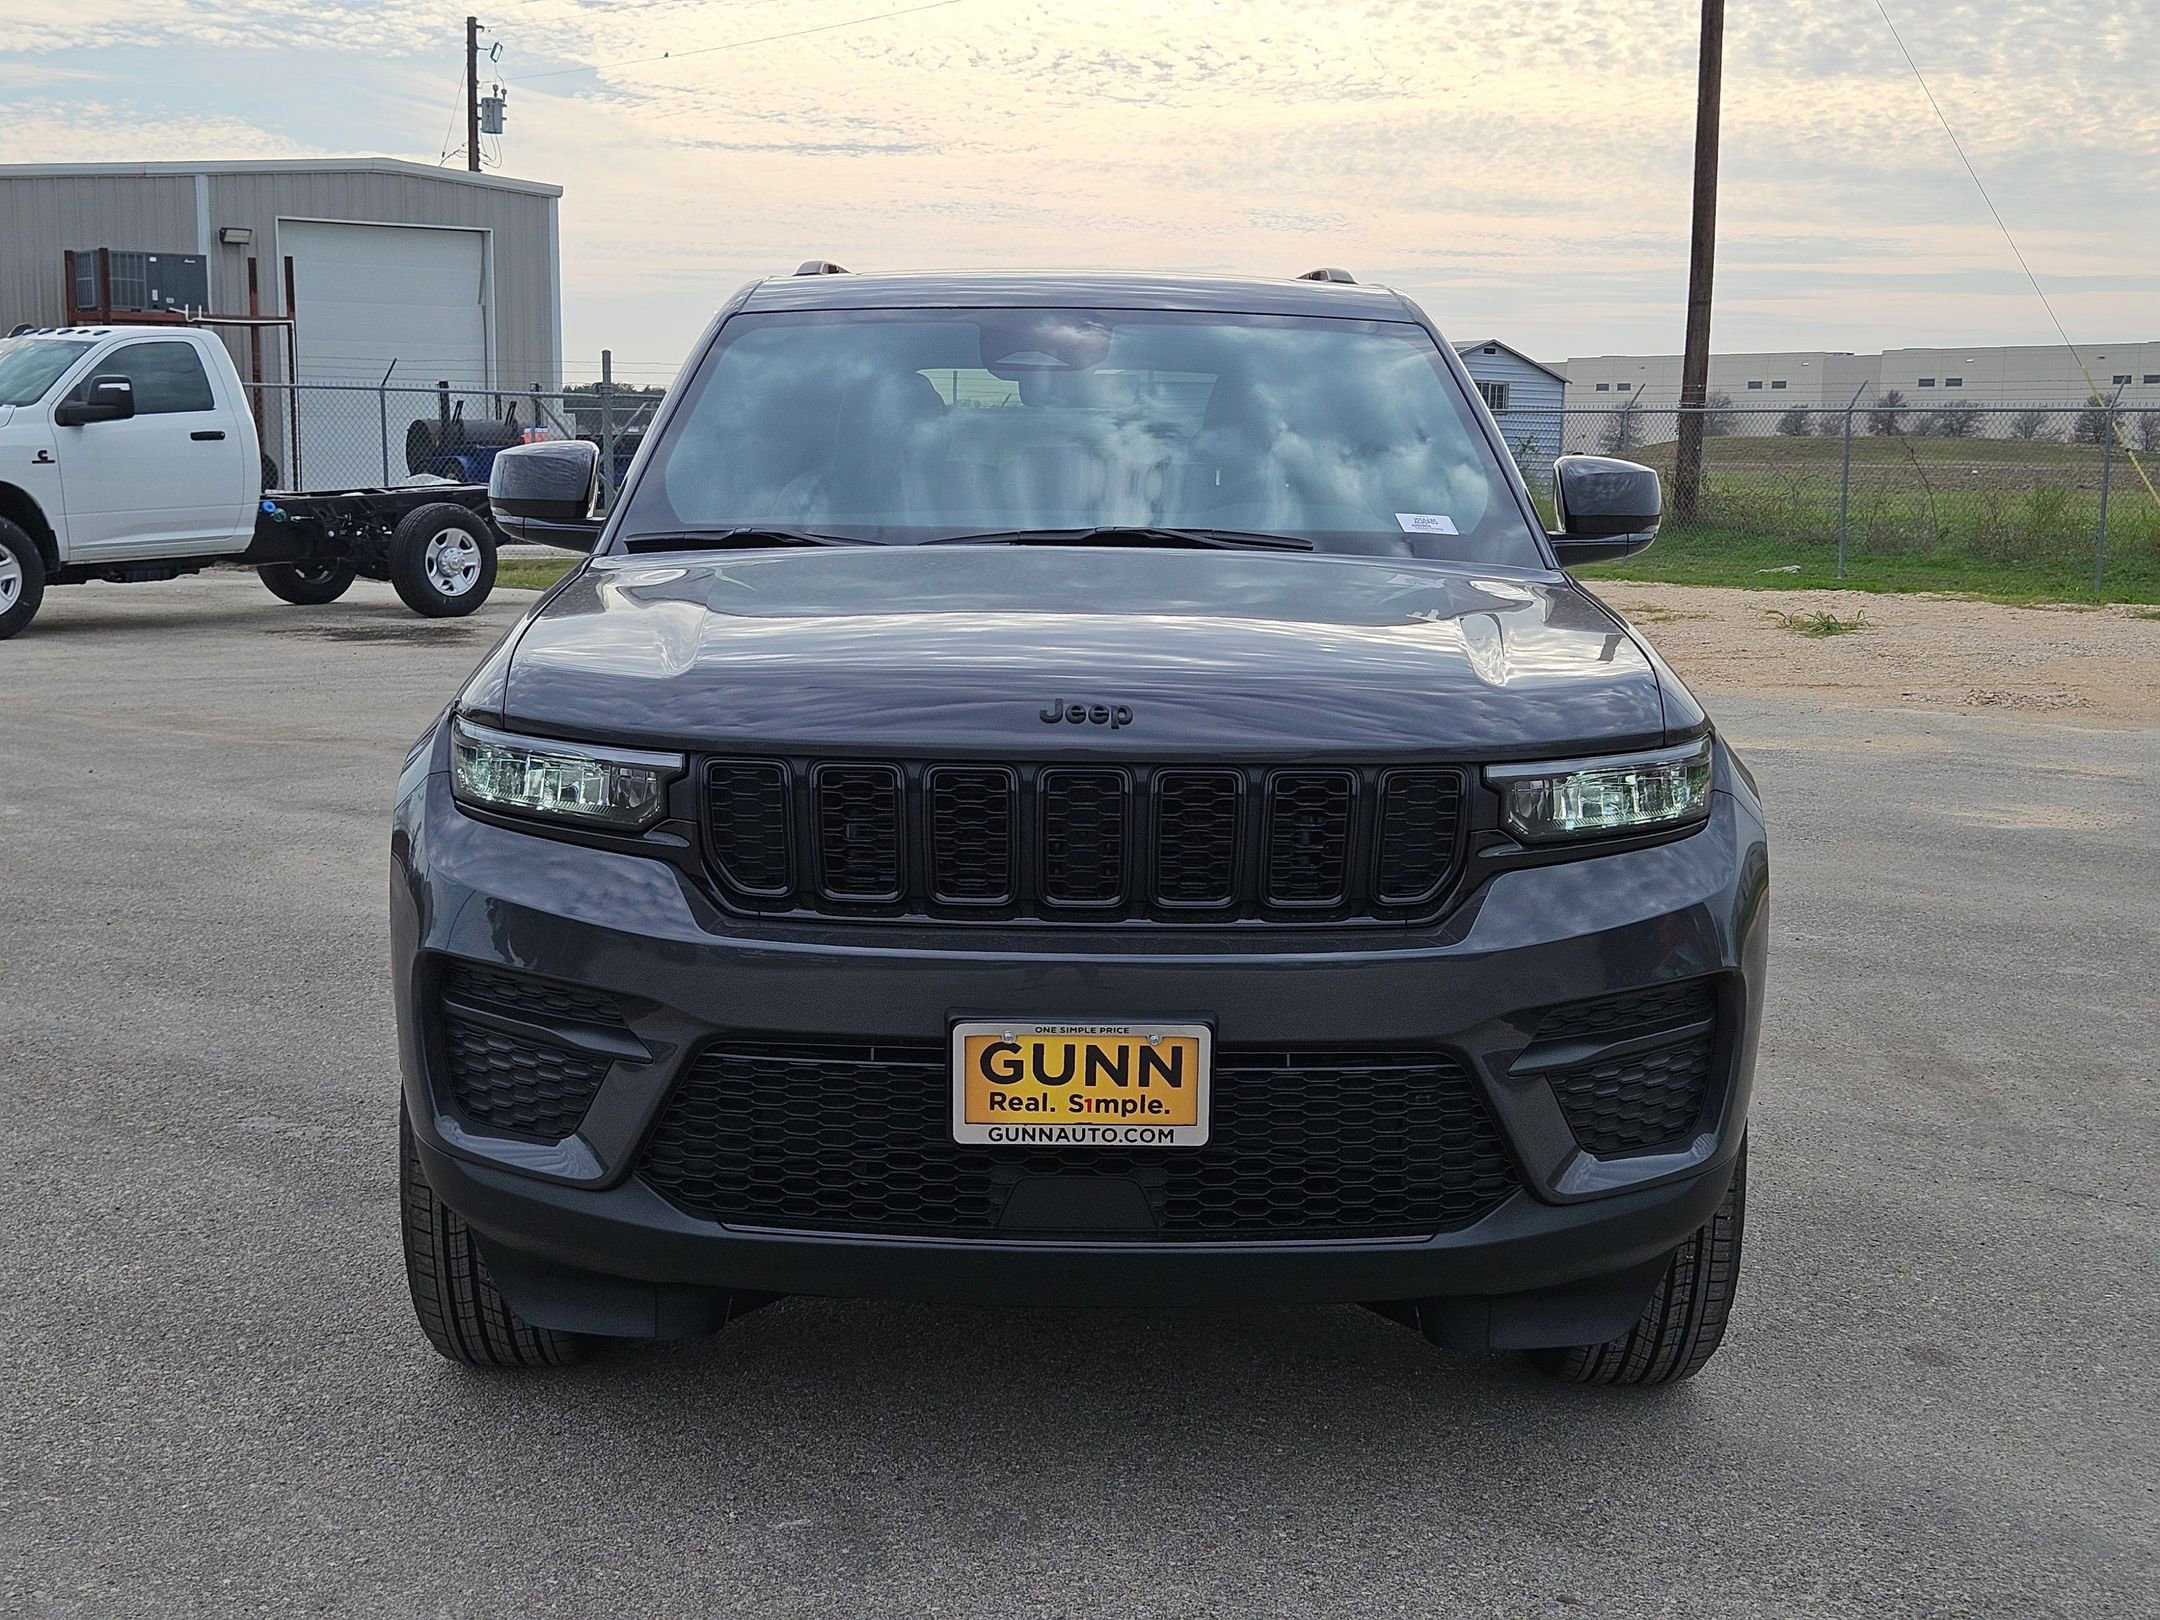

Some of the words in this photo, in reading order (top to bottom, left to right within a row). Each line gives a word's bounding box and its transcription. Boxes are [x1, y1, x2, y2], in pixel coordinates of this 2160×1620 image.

[1040, 698, 1133, 730] Jeep
[1035, 1026, 1057, 1034] ONE
[1060, 1026, 1097, 1034] SIMPLE
[980, 1042, 1183, 1088] GUNN
[989, 1092, 1056, 1113] Real.
[988, 1127, 1175, 1143] GUNNAUTO.COM
